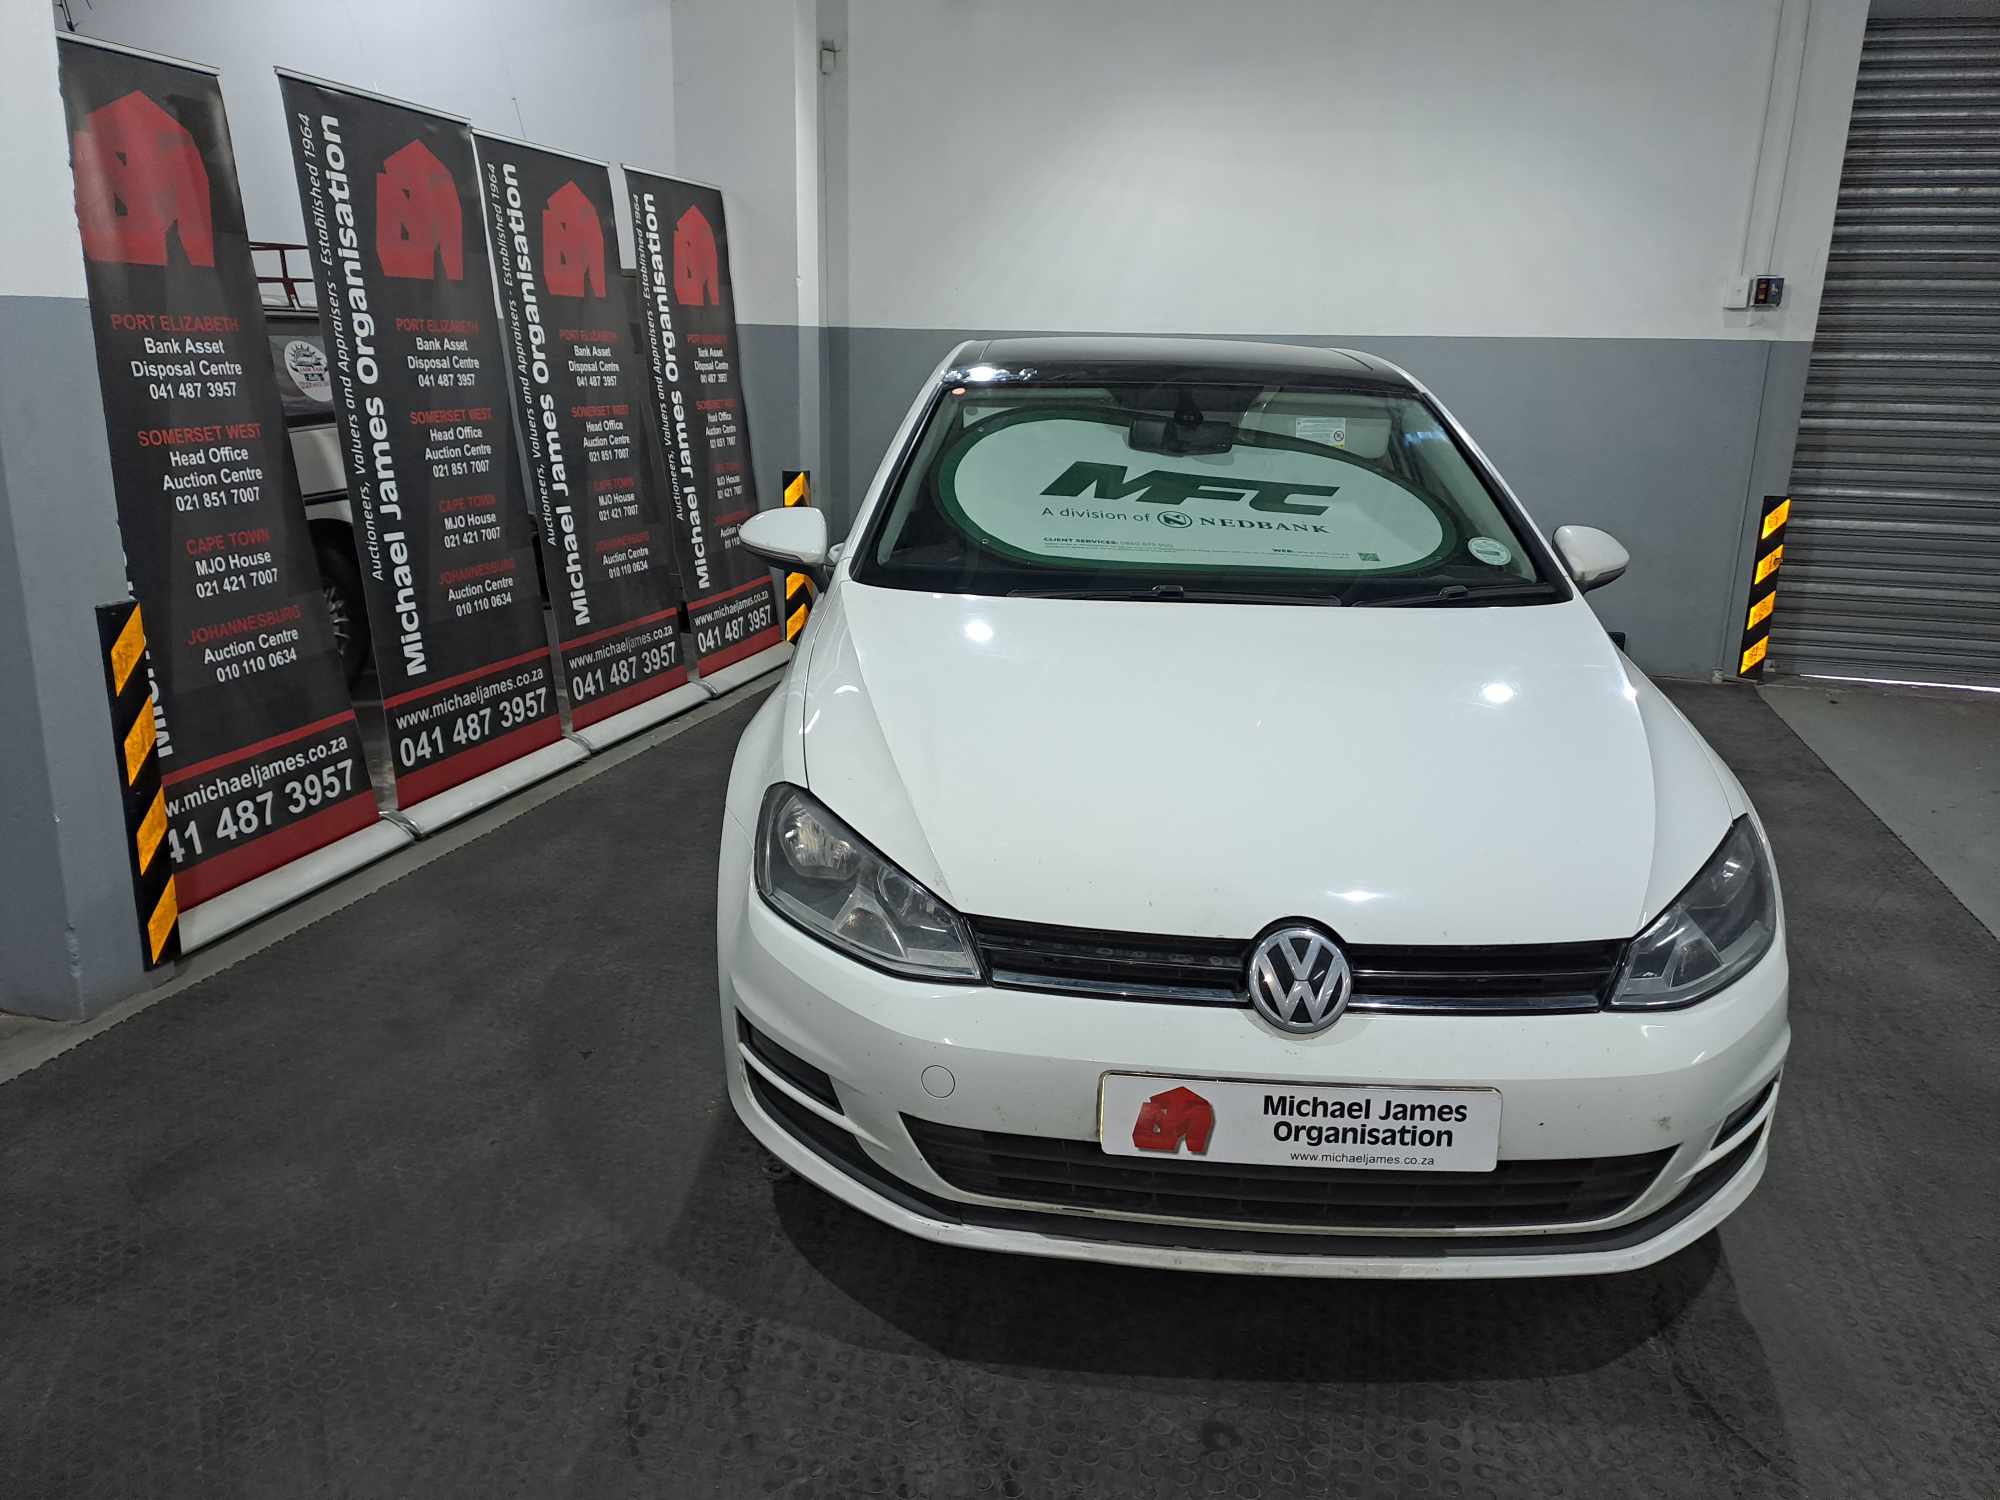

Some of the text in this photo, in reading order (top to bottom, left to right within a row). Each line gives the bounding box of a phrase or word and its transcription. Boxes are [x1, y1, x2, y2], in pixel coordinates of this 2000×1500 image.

[298, 112, 315, 159] 1964
[486, 162, 499, 197] 1964
[305, 163, 333, 266] Established
[494, 198, 513, 287] Established
[112, 314, 240, 333] PORT ELIZABETH
[327, 281, 351, 371] Appraisers
[509, 299, 528, 375] Appraisers
[144, 337, 224, 355] Bank Asset
[416, 337, 468, 351] Bank Asset
[131, 360, 242, 381] Disposal Centre
[408, 355, 480, 371] Disposal Centre
[568, 360, 597, 374] Disposal
[149, 381, 238, 400] 041 487 3957
[343, 376, 359, 409] and
[418, 373, 475, 388] 041 487 3957
[521, 376, 534, 405] and
[643, 192, 711, 590] Michael James Organisation
[320, 114, 427, 676] Michael James Organisation
[502, 163, 591, 627] Michael James Organisation
[137, 423, 262, 447] SOMERSET WEST
[430, 426, 482, 443] Head Office
[527, 407, 541, 459] Valuers
[603, 419, 624, 431] Office
[350, 411, 367, 475] Valuers
[425, 443, 492, 461] Auction Centre
[583, 434, 631, 448] Auction Centre
[169, 447, 249, 468] Head Office
[432, 460, 490, 478] 021 851 7007
[163, 466, 263, 491] Auction Centre
[1040, 461, 1340, 516] MFC
[176, 486, 260, 512] 021 851 7007
[537, 463, 557, 546] Auctioneers,
[613, 492, 635, 504] House
[360, 481, 384, 581] Auctioneers,
[444, 512, 497, 530] MJO House
[1041, 507, 1054, 516] A
[1060, 508, 1127, 521] division
[1133, 511, 1151, 522] of
[1199, 517, 1330, 535] NEDBANK
[186, 528, 270, 556] CAPE TOWN
[444, 526, 501, 549] 021 421 7007
[195, 549, 272, 578] MJO House
[602, 546, 649, 566] Auction Centre
[196, 567, 278, 599] 021 421 7007
[448, 575, 513, 602] Auction Centre
[456, 593, 512, 618] 010 110 0634
[698, 604, 771, 653] 041 487 3957
[204, 628, 299, 664] Auction Centre
[569, 623, 673, 670] www.michaeljames.co.za
[216, 647, 297, 683] 010 110 0634
[572, 641, 677, 702] 041 487 3957
[396, 666, 544, 730] www.michaeljames.co.za
[400, 687, 547, 768] 041 487 3957
[165, 736, 348, 818] w.michaeljames.co.za
[167, 758, 353, 864] 41 487 3957
[1263, 1095, 1468, 1122] Michael James
[1273, 1121, 1453, 1147] Organisation
[1290, 1152, 1434, 1166] www.michaeljames.co.za
